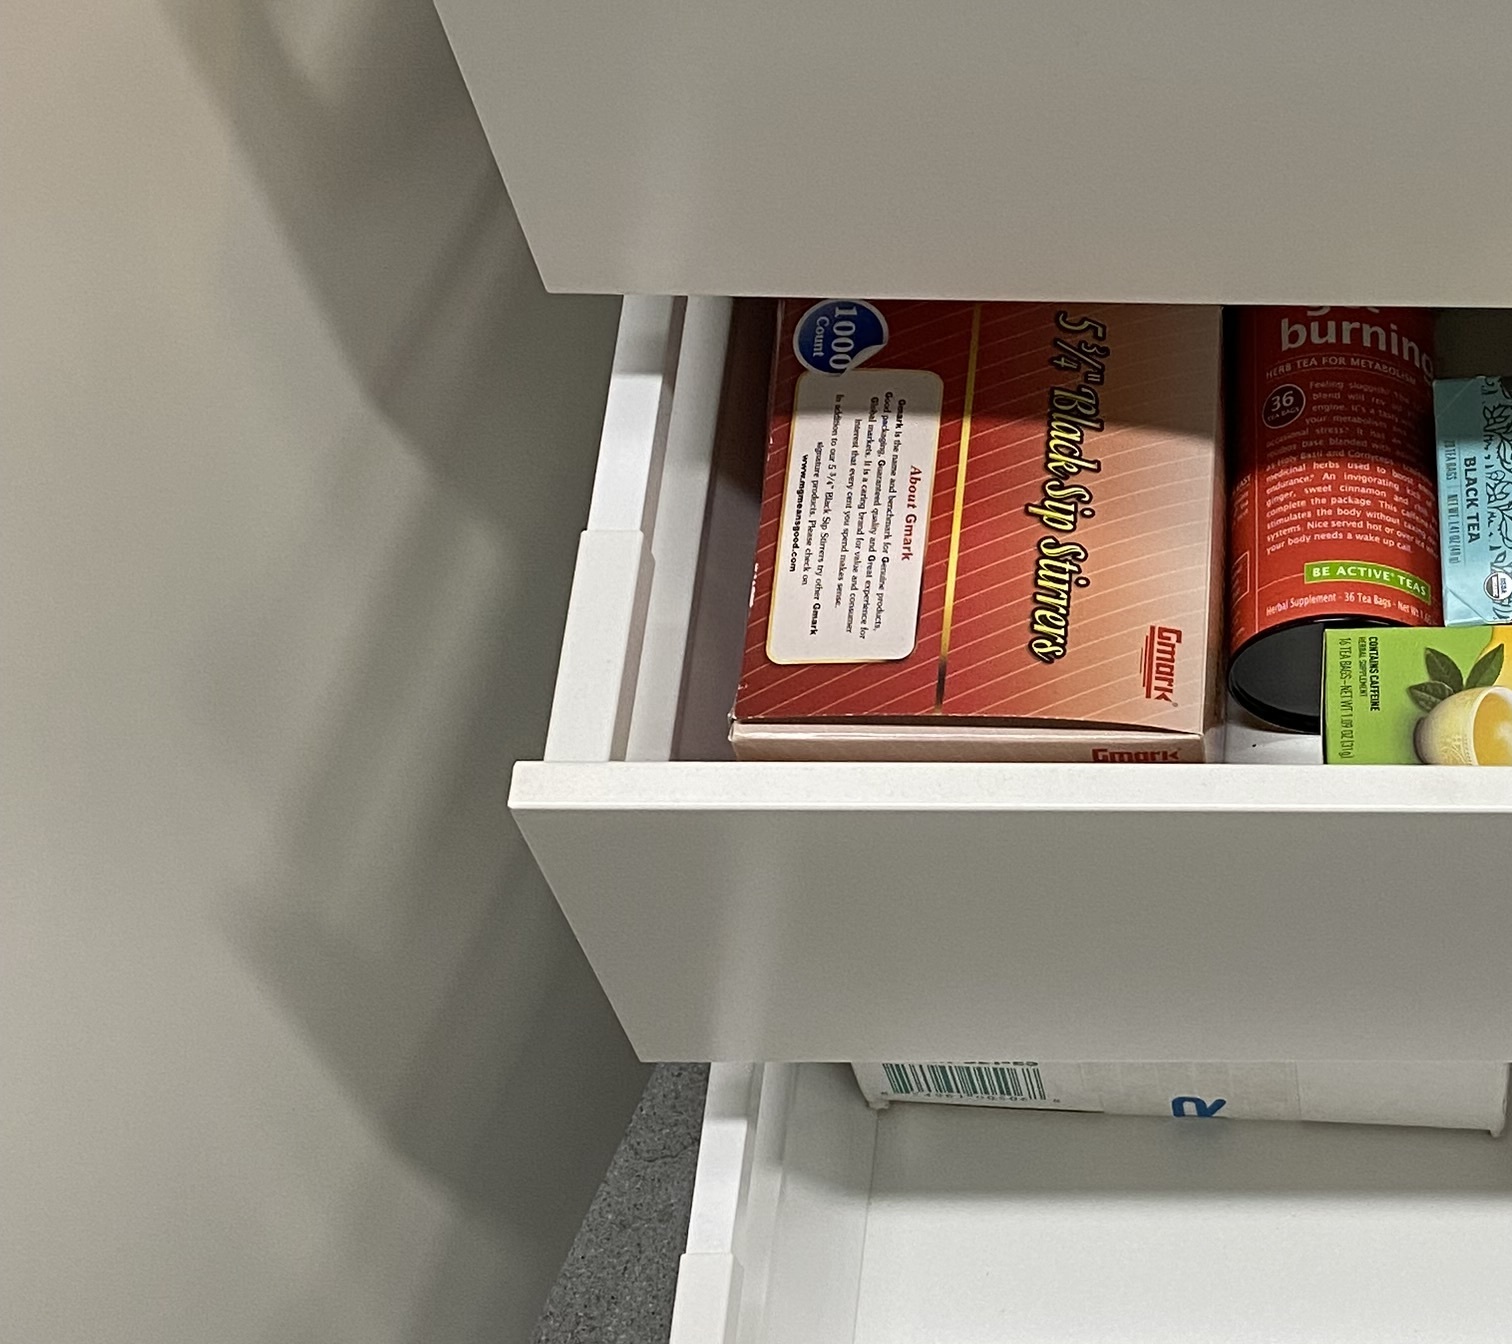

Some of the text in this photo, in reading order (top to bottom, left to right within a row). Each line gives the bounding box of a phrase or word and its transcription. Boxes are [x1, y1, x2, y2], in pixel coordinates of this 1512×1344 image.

[814, 316, 830, 358] Count
[1280, 317, 1434, 385] burning
[1295, 355, 1317, 367] TEA
[1322, 355, 1346, 365] FOR
[1270, 390, 1293, 411] 36
[846, 468, 854, 489] every
[874, 460, 885, 505] Guaranteed
[1028, 311, 1103, 661] 5 Black Sip Stirrers
[1304, 484, 1386, 496] sweet cinnamon
[902, 466, 921, 559] About Gmark
[1337, 507, 1361, 517] body
[1464, 456, 1481, 544] BLACK TEA
[856, 512, 866, 534] brand
[884, 495, 895, 538] benchmark
[1307, 521, 1328, 529] Nice
[1366, 521, 1381, 530] hot
[1313, 531, 1380, 542] needs wake
[803, 548, 812, 571] check
[838, 555, 846, 580] makes
[1312, 567, 1329, 576] BE
[1397, 576, 1426, 595] TEAS
[846, 593, 855, 632] consumer
[861, 580, 870, 623] experience
[1266, 601, 1288, 616] Herbal
[1290, 594, 1336, 607] Supplement
[1344, 592, 1354, 601] 36
[1357, 593, 1371, 603] Tea
[1373, 595, 1391, 608] Bags
[810, 603, 820, 634] Gmark
[1154, 626, 1183, 703] Gmark
[1339, 646, 1351, 659] TEA
[1369, 636, 1380, 712] CONTAINS CAFFEINE
[1092, 748, 1179, 762] Gmark
